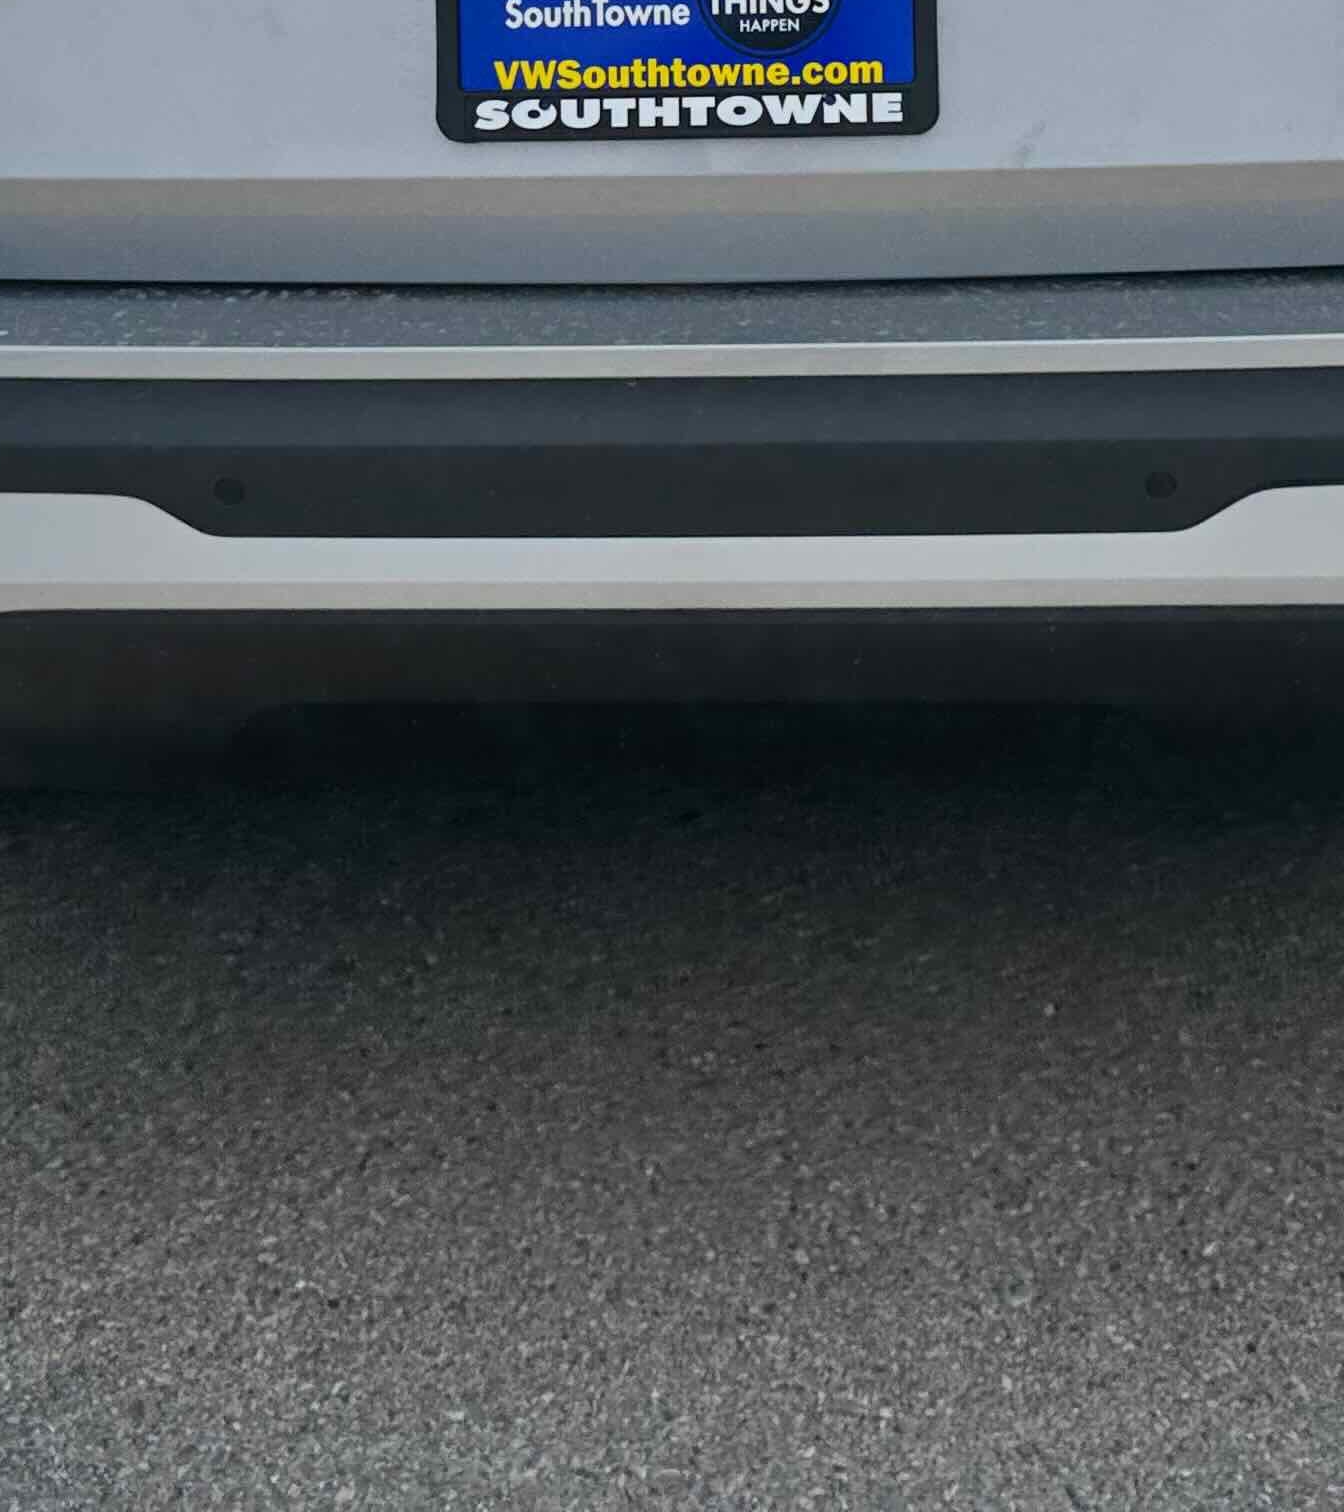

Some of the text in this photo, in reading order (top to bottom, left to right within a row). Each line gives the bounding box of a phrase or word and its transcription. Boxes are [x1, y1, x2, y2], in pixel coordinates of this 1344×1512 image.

[739, 17, 800, 33] HAPPEN
[494, 57, 884, 90] VWSouthtowne.com
[474, 93, 903, 131] SOUTHTOWNE
